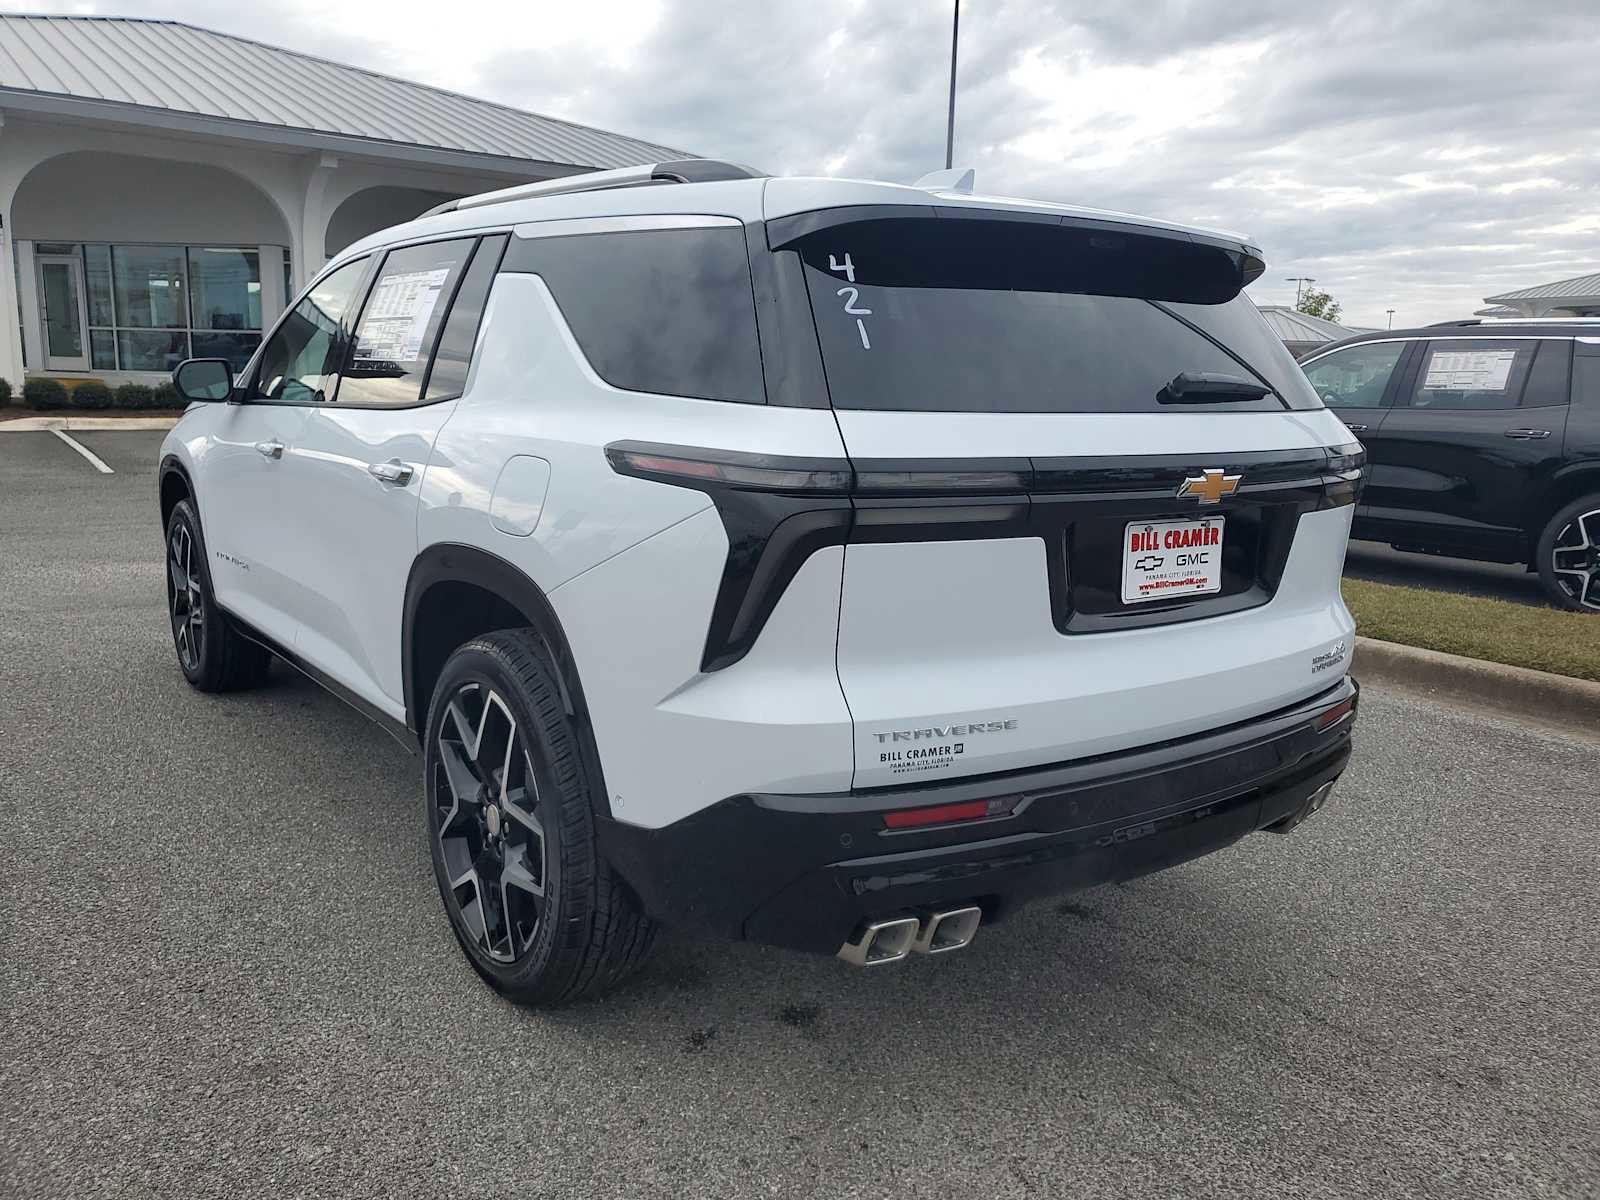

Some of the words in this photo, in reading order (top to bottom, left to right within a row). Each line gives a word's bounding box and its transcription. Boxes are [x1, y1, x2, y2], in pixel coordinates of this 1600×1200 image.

[1131, 530, 1159, 552] BILL
[1164, 527, 1219, 549] CRAMER
[1176, 552, 1209, 566] GMC
[1145, 572, 1167, 581] PANAMA
[1182, 569, 1201, 577] FLORIDA
[872, 719, 1019, 743] TRAVERSE
[880, 751, 902, 762] BILL
[906, 746, 951, 760] CRAMER
[889, 761, 916, 769] PANAMA
[931, 756, 954, 764] FLORIDA
